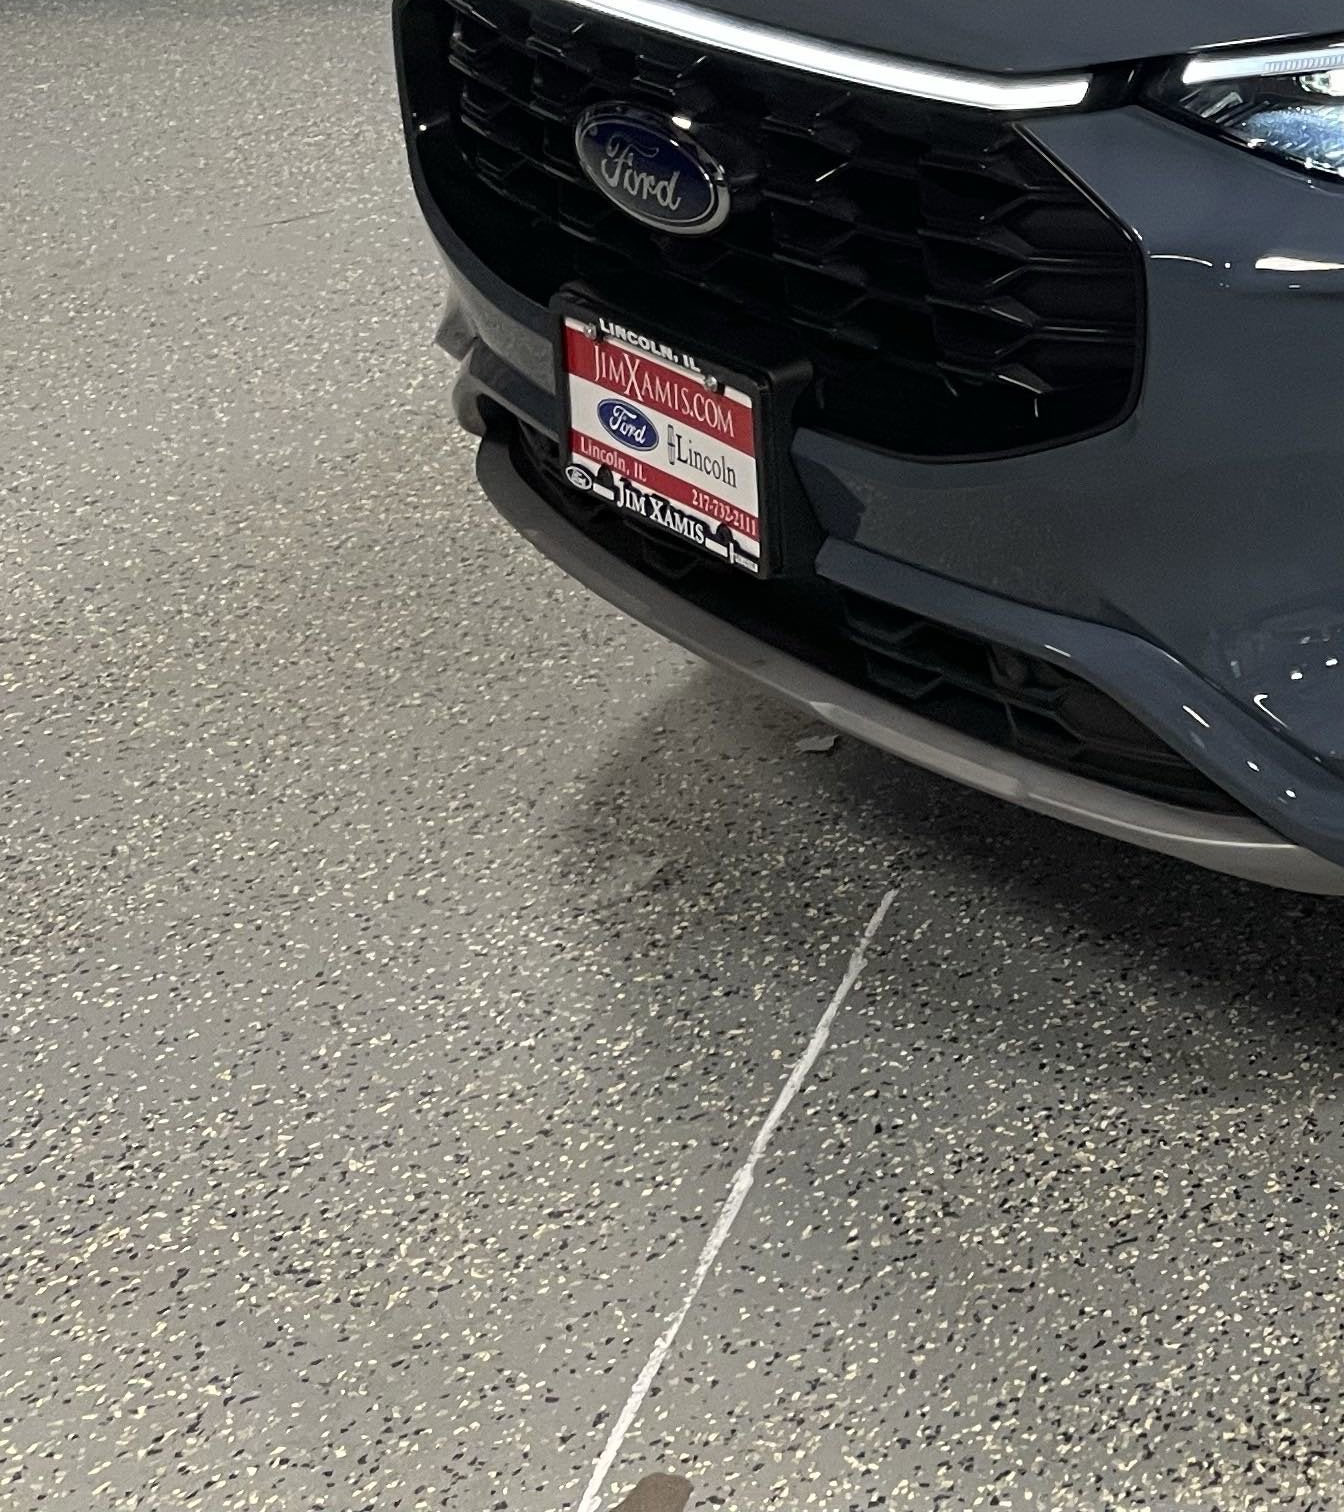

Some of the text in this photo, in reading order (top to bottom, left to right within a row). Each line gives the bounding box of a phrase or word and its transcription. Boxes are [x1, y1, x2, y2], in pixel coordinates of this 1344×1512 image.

[601, 135, 681, 210] Ford
[599, 317, 701, 372] LINCOLN, IL
[594, 345, 735, 438] JIMXAMIS.COM
[580, 436, 647, 482] Lincoln, IL
[676, 434, 736, 488] Lincoln
[616, 478, 704, 544] JIM XAMIS
